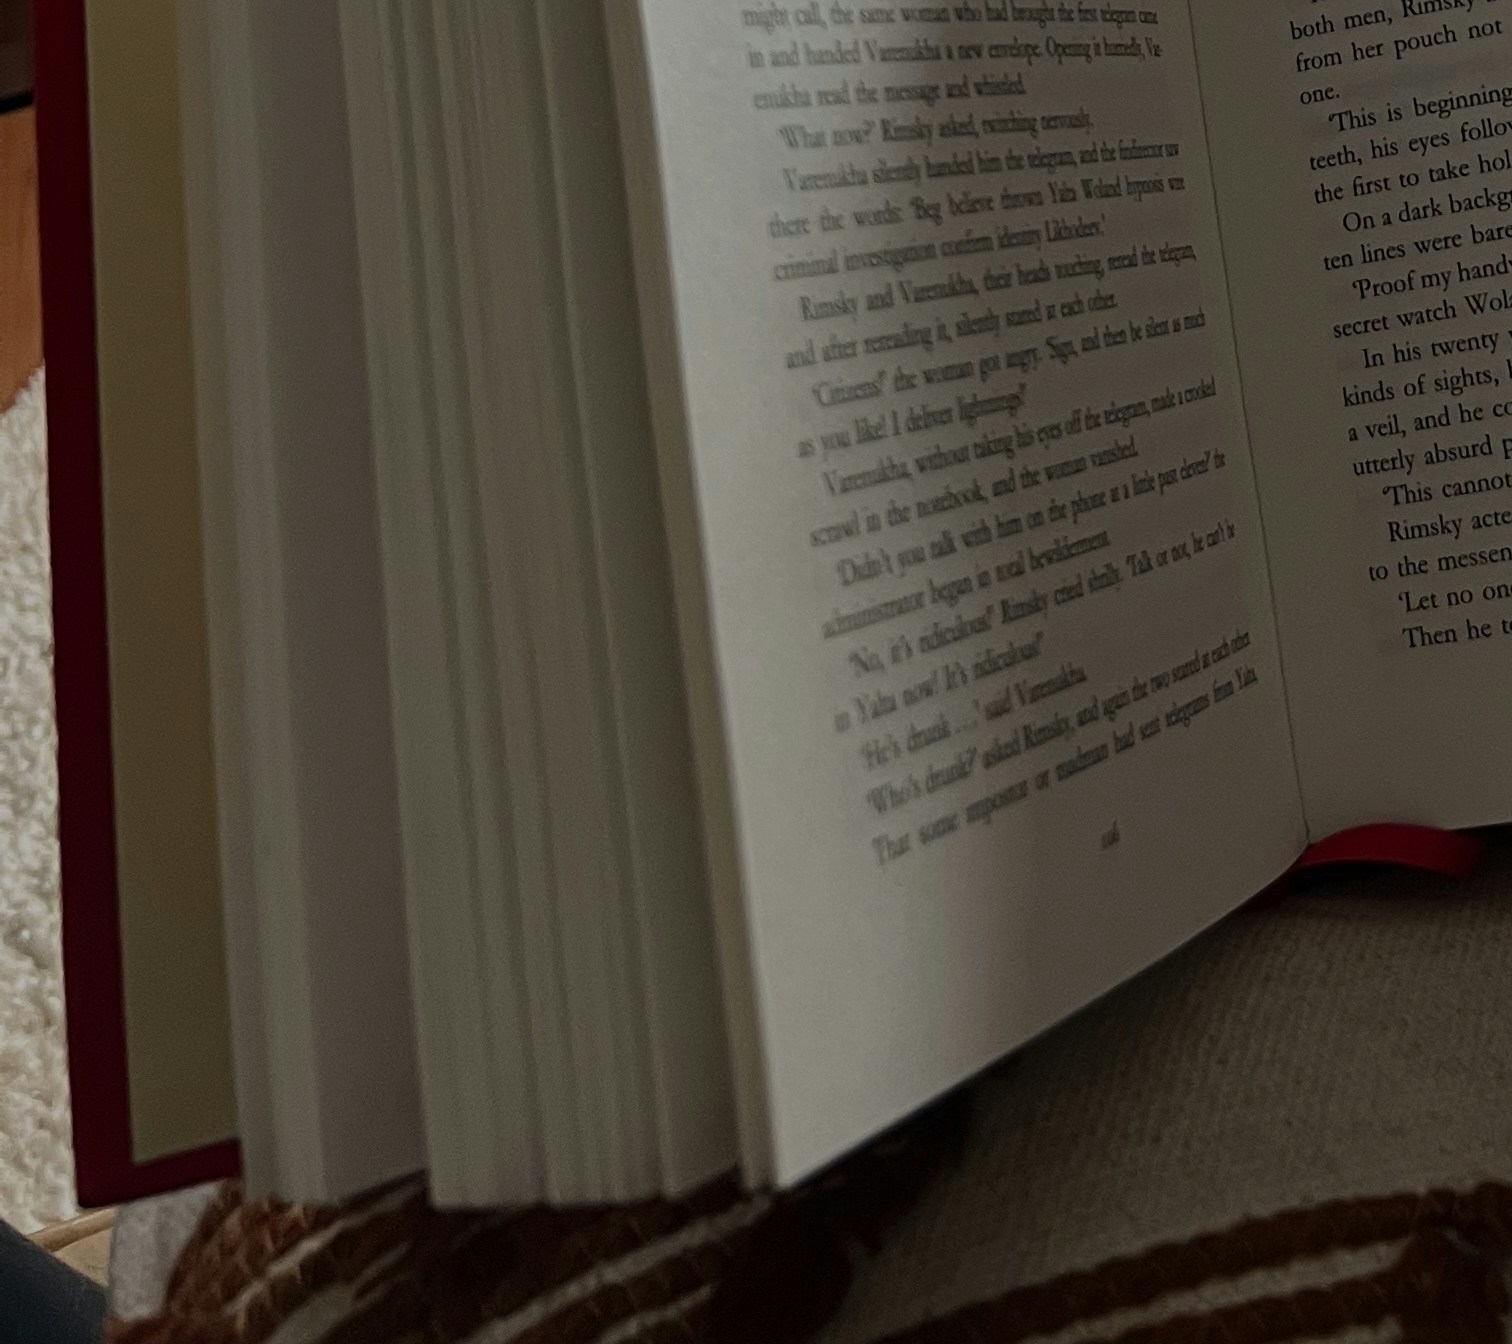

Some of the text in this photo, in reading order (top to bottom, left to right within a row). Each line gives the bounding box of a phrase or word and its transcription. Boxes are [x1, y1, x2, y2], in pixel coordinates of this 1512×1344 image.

[1295, 50, 1343, 73] from
[1349, 40, 1384, 61] her
[1392, 22, 1458, 61] pouch
[1467, 19, 1503, 40] not
[1341, 210, 1376, 232] On
[1380, 211, 1393, 226] a
[1397, 196, 1444, 223] dark
[1347, 426, 1359, 442] a
[1363, 412, 1407, 439] veil,
[1412, 403, 1452, 432] and
[1456, 401, 1484, 424] he
[1400, 624, 1458, 649] Then
[1464, 617, 1493, 641] he
